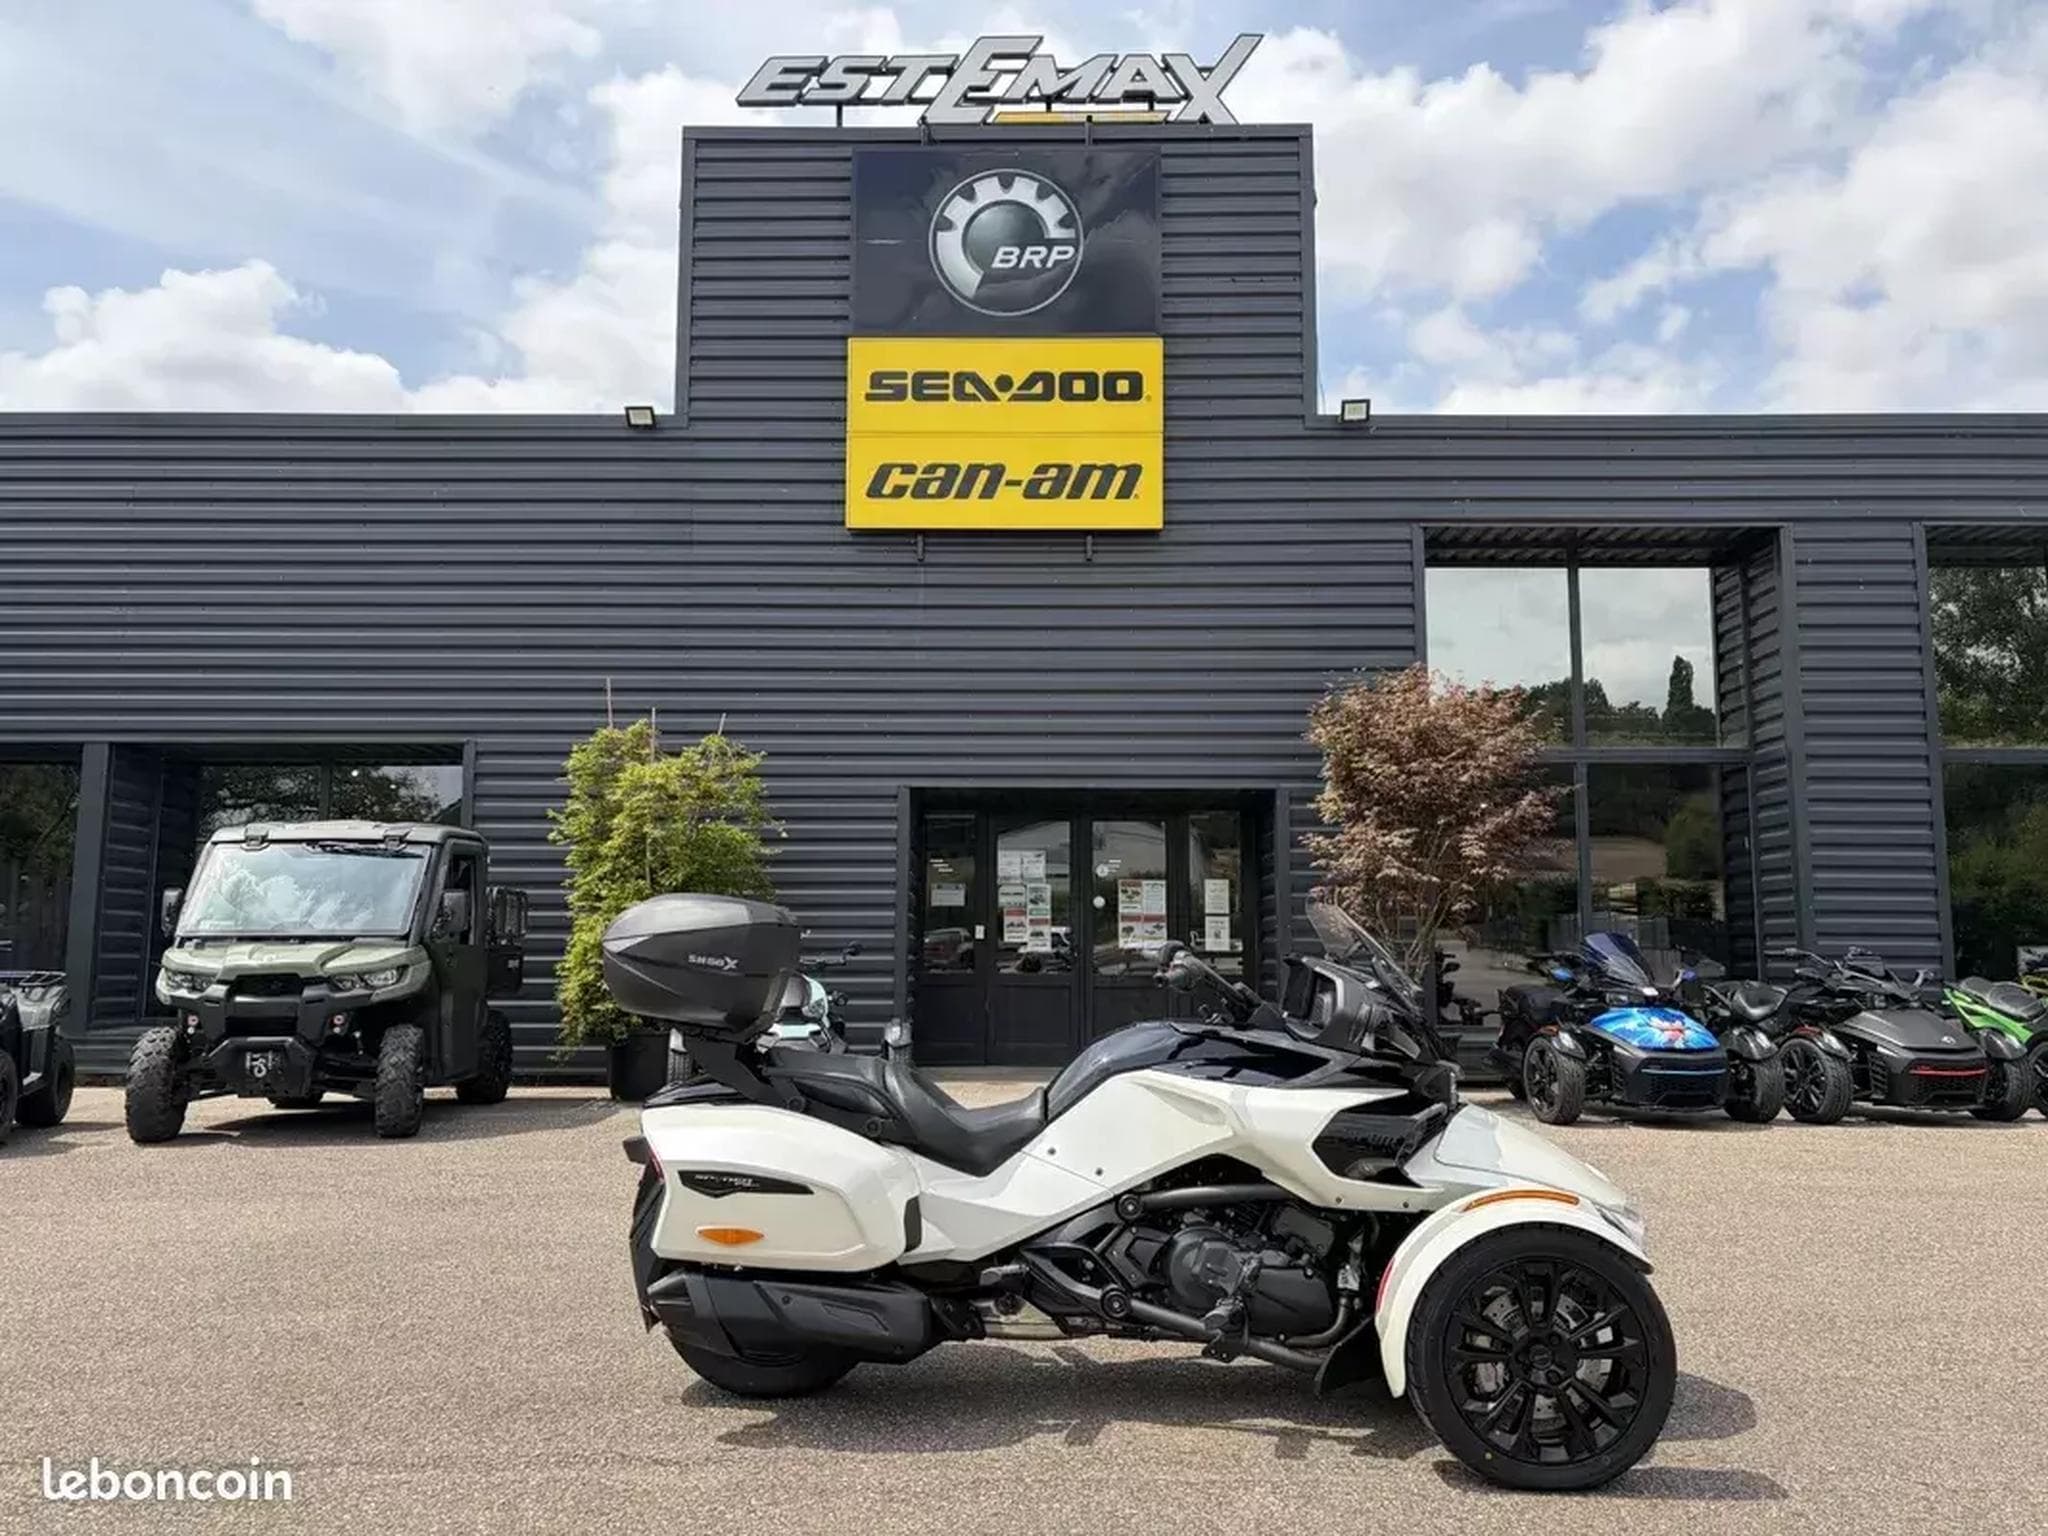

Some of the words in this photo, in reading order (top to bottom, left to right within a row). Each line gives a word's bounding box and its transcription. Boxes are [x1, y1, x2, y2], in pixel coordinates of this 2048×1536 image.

[736, 34, 1264, 126] ESTEMAX
[991, 245, 1076, 270] BRP
[865, 462, 1143, 500] can-am
